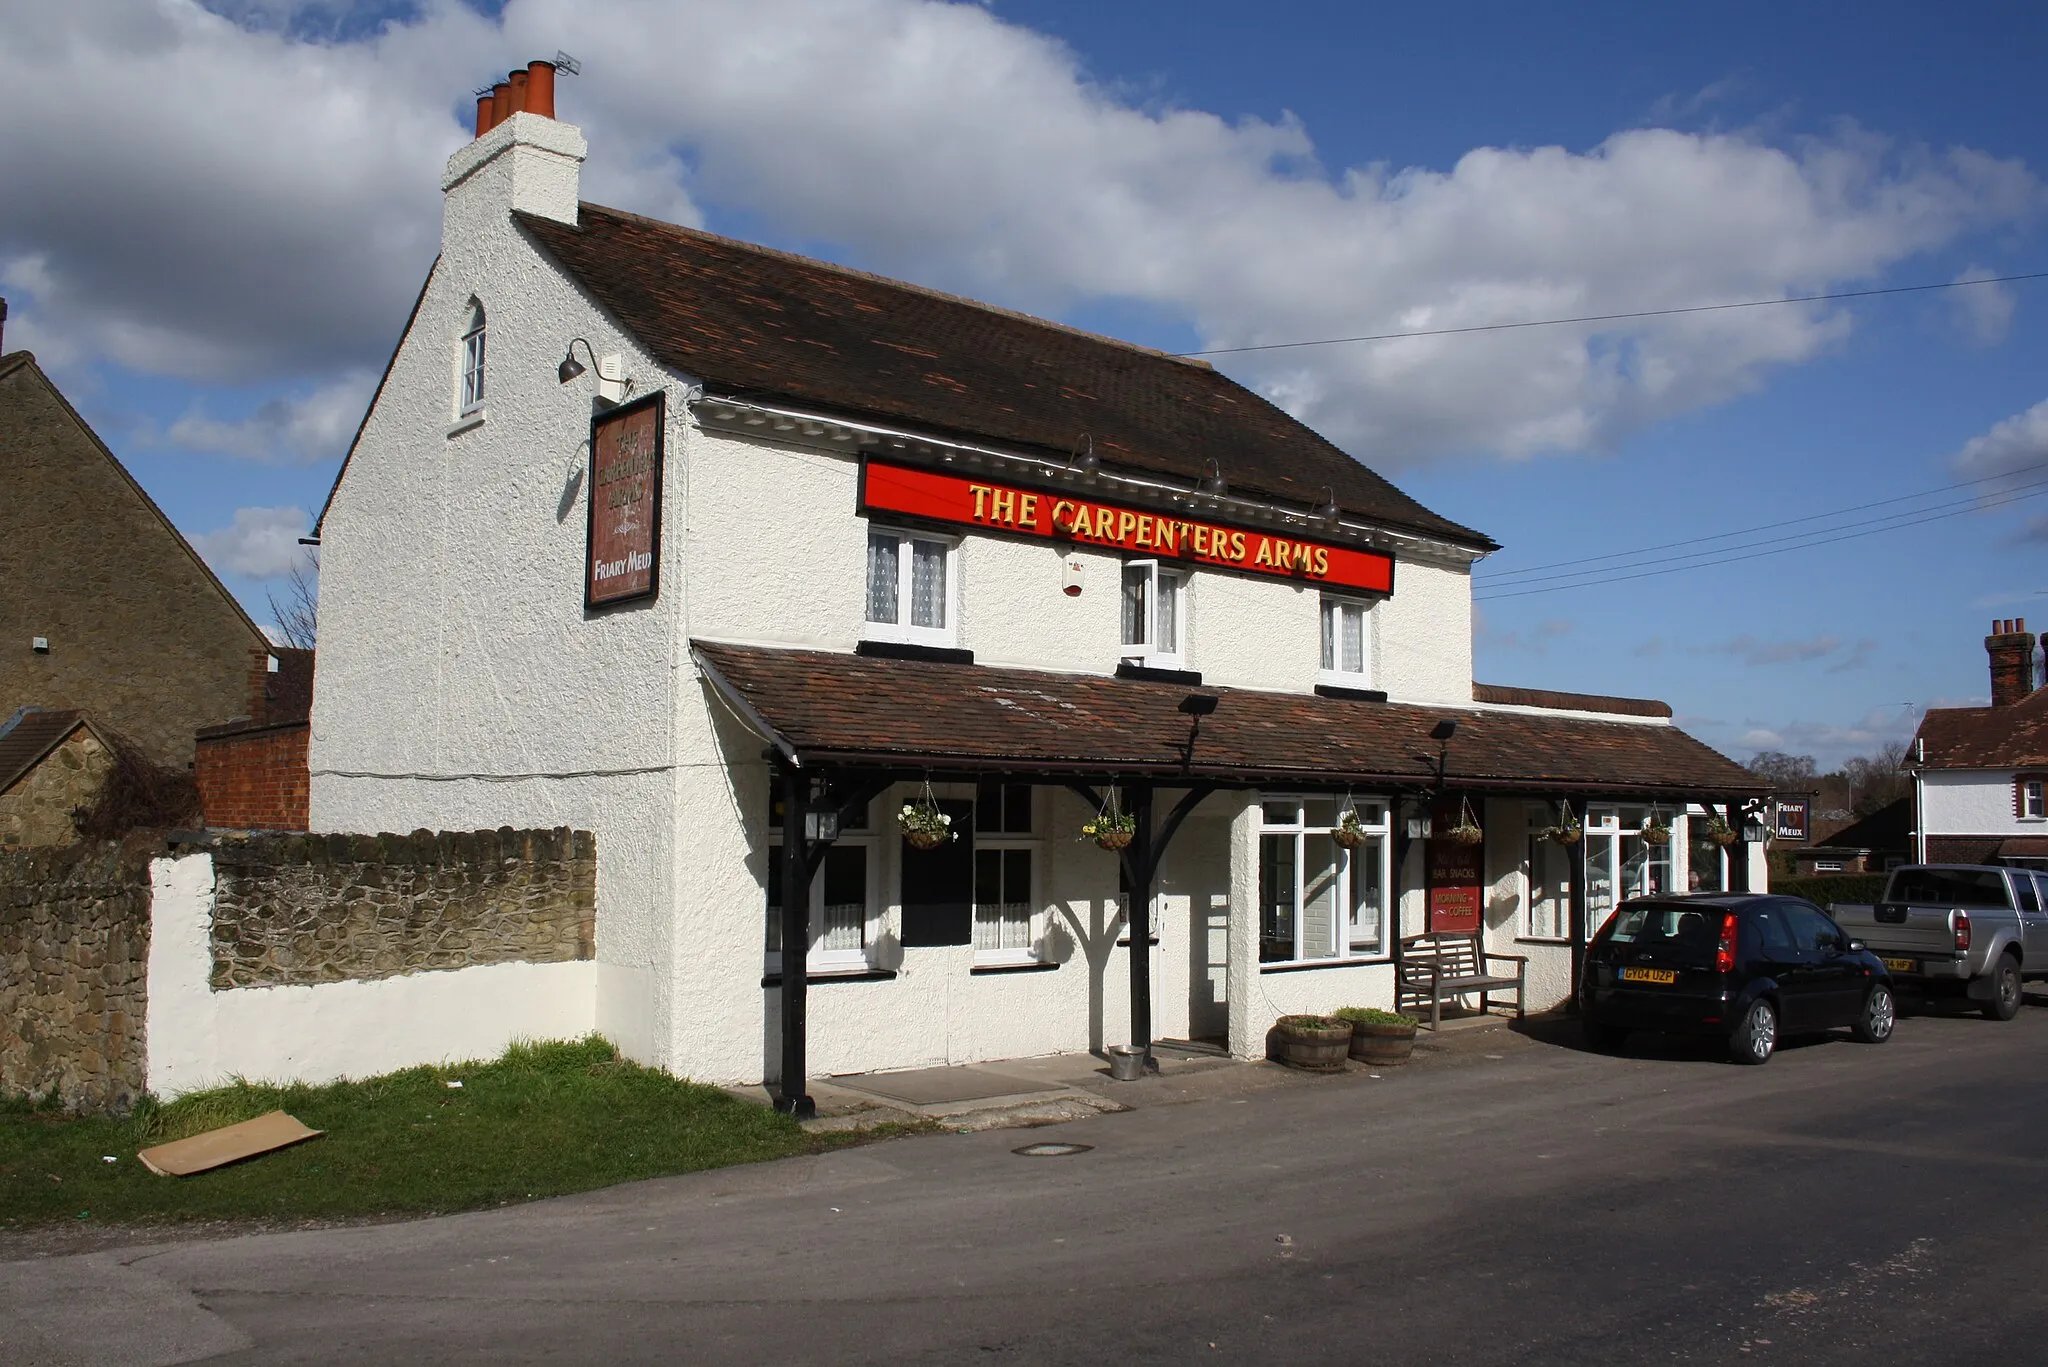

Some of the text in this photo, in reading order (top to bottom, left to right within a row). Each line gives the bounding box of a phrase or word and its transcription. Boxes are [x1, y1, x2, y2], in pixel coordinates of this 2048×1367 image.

[969, 484, 1328, 575] THE CARPENTERS ARMS
[1433, 868, 1475, 879] BAR SNACKS
[1436, 893, 1467, 905] MORNING
[1449, 906, 1473, 917] COFFEE
[1626, 968, 1673, 981] GY04 UZP
